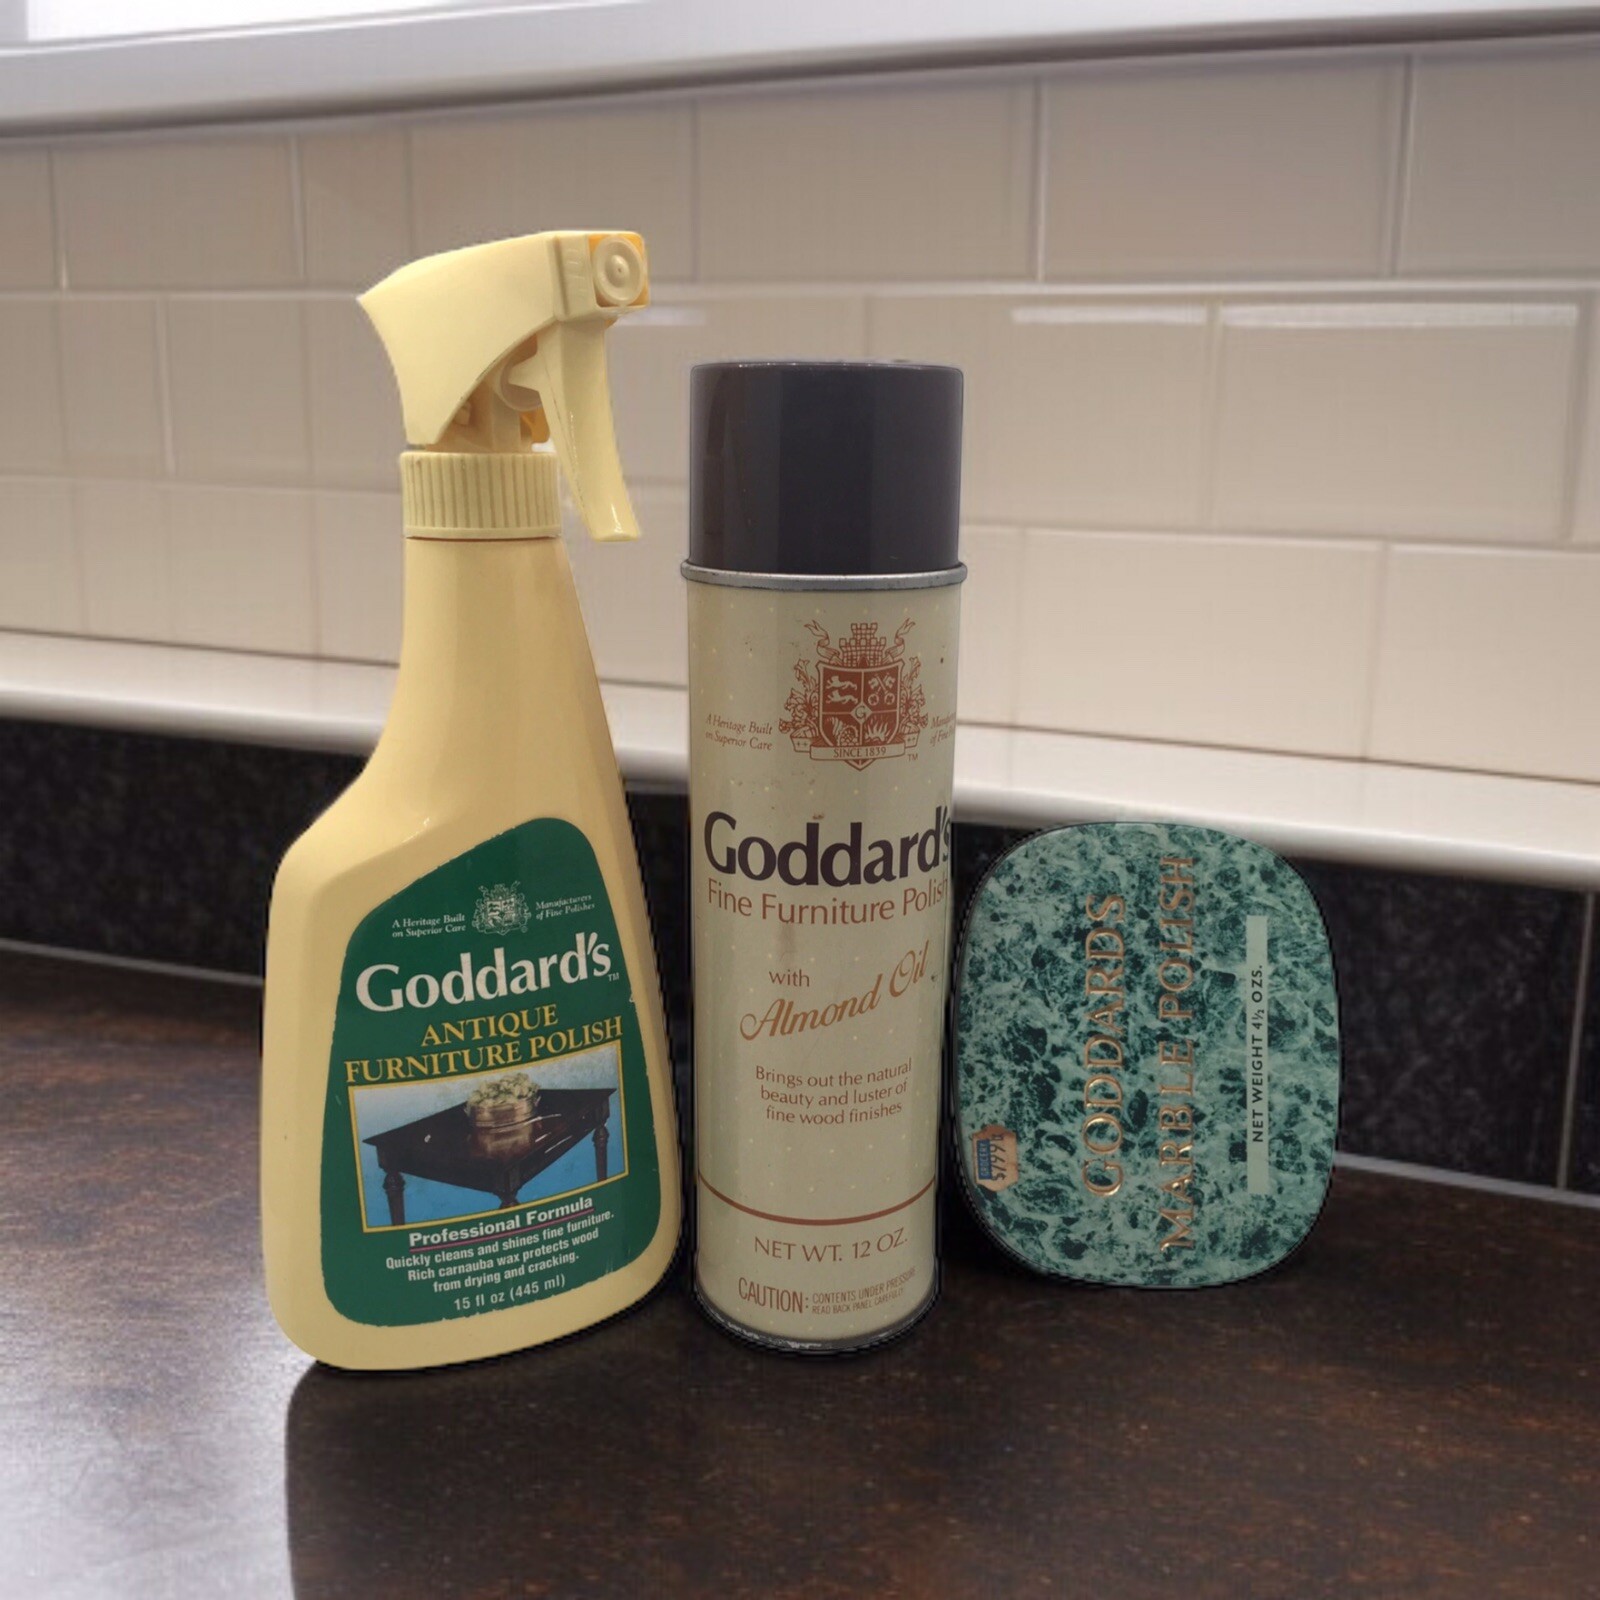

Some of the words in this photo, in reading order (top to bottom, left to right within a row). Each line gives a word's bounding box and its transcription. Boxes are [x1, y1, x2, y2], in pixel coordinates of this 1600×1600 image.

[705, 714, 713, 724] A
[713, 715, 746, 734] Heritage
[749, 722, 773, 735] Built
[714, 732, 747, 748] Superior
[749, 737, 773, 750] Care
[834, 748, 862, 758] SINCE
[865, 747, 887, 757] 1839
[536, 894, 592, 910] Manufacturers
[536, 910, 544, 920] of
[545, 909, 562, 918] Fine
[565, 902, 595, 914] Polishes
[708, 878, 752, 917] Fine
[762, 894, 895, 925] Furniture
[903, 873, 948, 916] Polish
[392, 919, 400, 929] A
[403, 918, 441, 927] Heritage
[443, 913, 465, 924] Built
[406, 927, 443, 938] Superior
[445, 924, 466, 933] Care
[1158, 856, 1196, 1022] POLISH
[355, 931, 612, 1013] Goddard's
[740, 973, 883, 1041] Almond
[889, 939, 929, 997] Oil
[769, 969, 810, 987] with
[1251, 964, 1263, 1004] OZS.
[421, 1003, 559, 1047] ANTIQUE
[344, 1041, 523, 1083] FURNITURE
[529, 1015, 624, 1059] POLISH
[1081, 894, 1126, 1197] GODDARDS
[755, 1065, 803, 1089] Brings
[807, 1074, 834, 1088] out
[838, 1071, 863, 1086] the
[867, 1057, 912, 1083] natural
[1252, 1034, 1264, 1104] WEIGHT
[761, 1085, 813, 1109] beauty
[818, 1091, 848, 1105] and
[853, 1086, 892, 1104] luster
[895, 1077, 908, 1095] of
[766, 1105, 796, 1124] fine
[800, 1109, 845, 1125] wood
[849, 1101, 902, 1124] finishes
[1252, 1110, 1264, 1143] NET
[1158, 1037, 1196, 1252] MARBLE
[408, 1215, 521, 1247] Professional
[526, 1197, 593, 1226] Formula
[386, 1255, 431, 1270] Quickly
[434, 1248, 474, 1263] cleans
[477, 1242, 499, 1255] and
[502, 1234, 540, 1250] shines
[542, 1227, 564, 1241] fine
[567, 1212, 615, 1234] furniture.
[407, 1269, 435, 1281] Rich
[438, 1259, 494, 1277] carnauba
[497, 1253, 520, 1267] wax
[522, 1240, 570, 1263] protects
[572, 1228, 599, 1246] wood
[754, 1236, 796, 1260] NET
[802, 1244, 843, 1262] WT.
[852, 1240, 871, 1259] 12
[877, 1227, 908, 1252] OZ.
[433, 1281, 462, 1293] from
[464, 1270, 501, 1289] drying
[504, 1266, 526, 1280] and
[528, 1252, 580, 1274] cracking.
[453, 1298, 471, 1311] 15
[475, 1294, 486, 1307] fl
[490, 1292, 506, 1304] oz
[510, 1281, 540, 1302] (445
[544, 1273, 566, 1290] ml)
[812, 1290, 857, 1304] CONTENTS
[858, 1283, 885, 1299] UNDER
[812, 1305, 831, 1315] READ
[833, 1304, 851, 1314] BACK
[852, 1301, 873, 1312] PANEL
